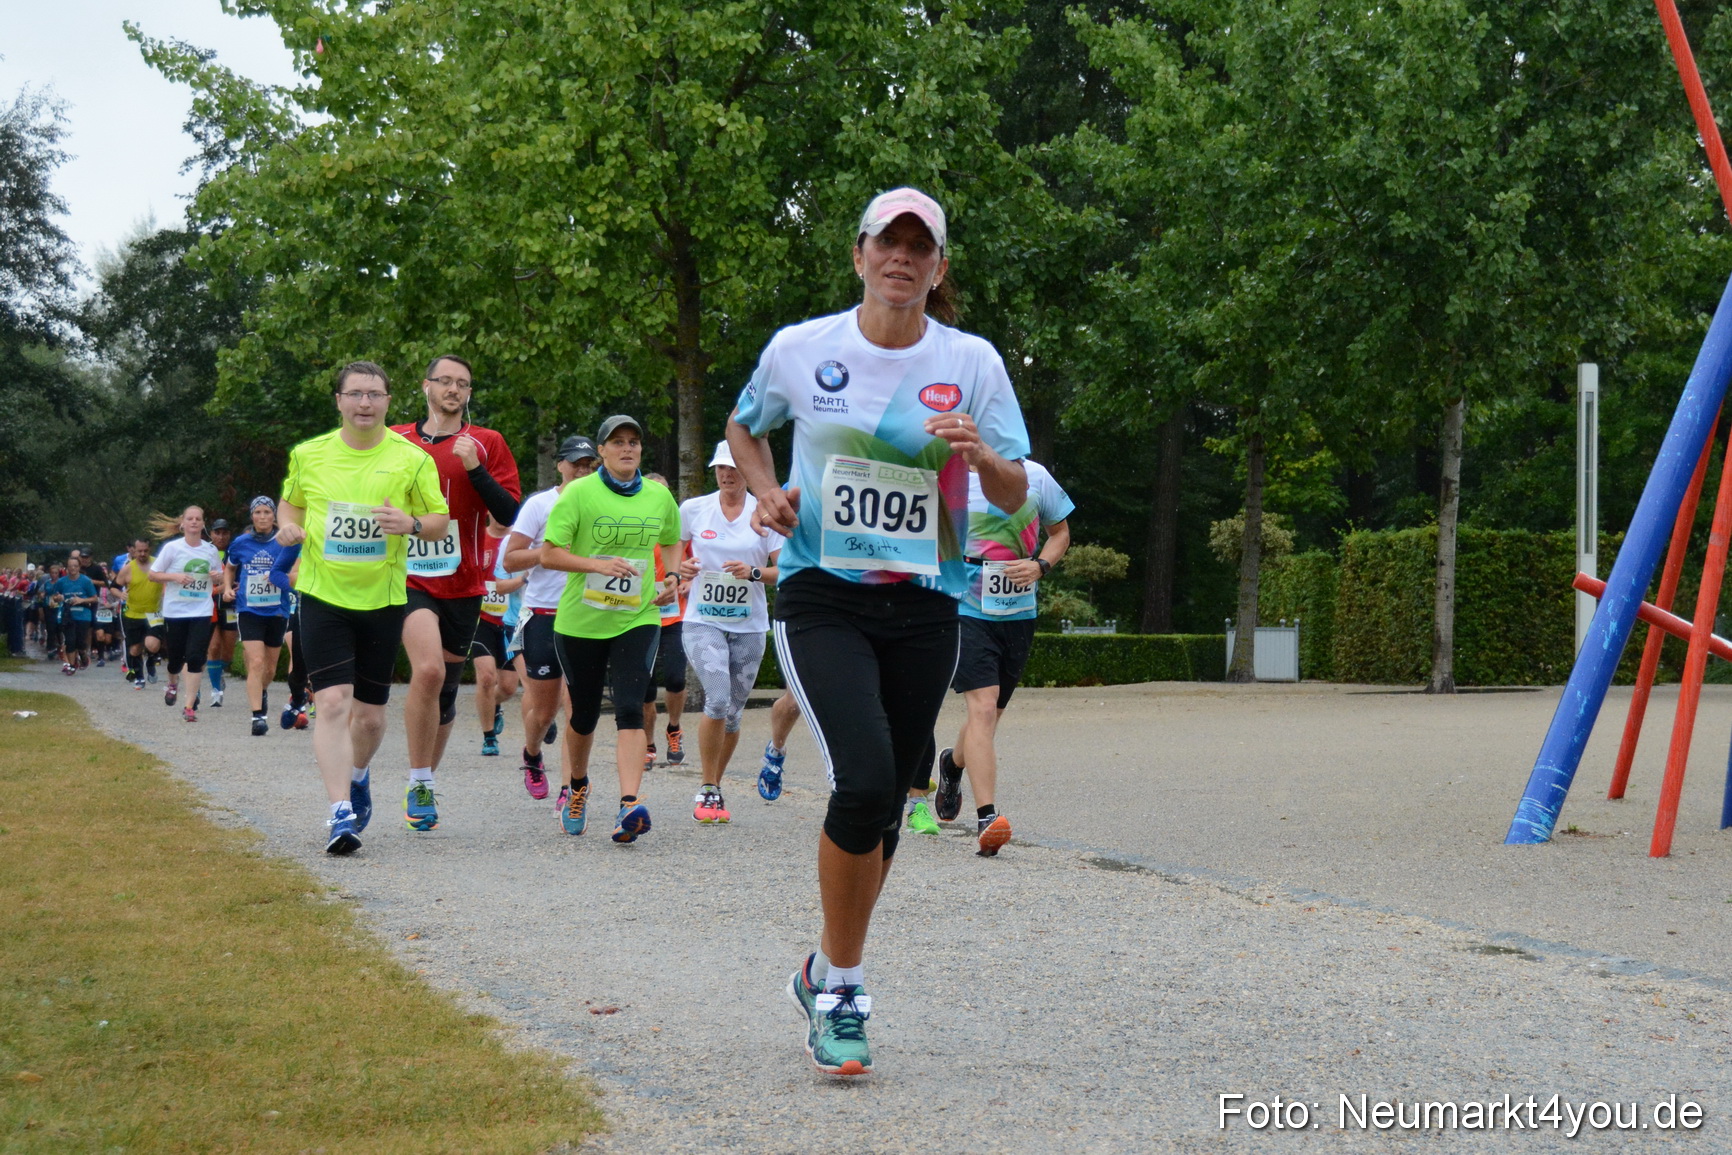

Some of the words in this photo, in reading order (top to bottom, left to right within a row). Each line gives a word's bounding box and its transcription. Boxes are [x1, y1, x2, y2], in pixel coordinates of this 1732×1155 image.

[819, 361, 848, 374] BMW
[813, 395, 849, 407] PARTL
[813, 405, 849, 414] Neumarkt
[832, 468, 870, 479] NeuerMarkt
[834, 484, 929, 533] 3095
[331, 516, 383, 539] 2392
[337, 544, 376, 554] Christian
[407, 535, 455, 558] 2018
[845, 536, 902, 556] Brigitte
[413, 561, 449, 570] Christian
[183, 580, 208, 591] 2434
[250, 583, 277, 595] 2541
[605, 574, 631, 593] 26
[703, 583, 748, 604] 3092
